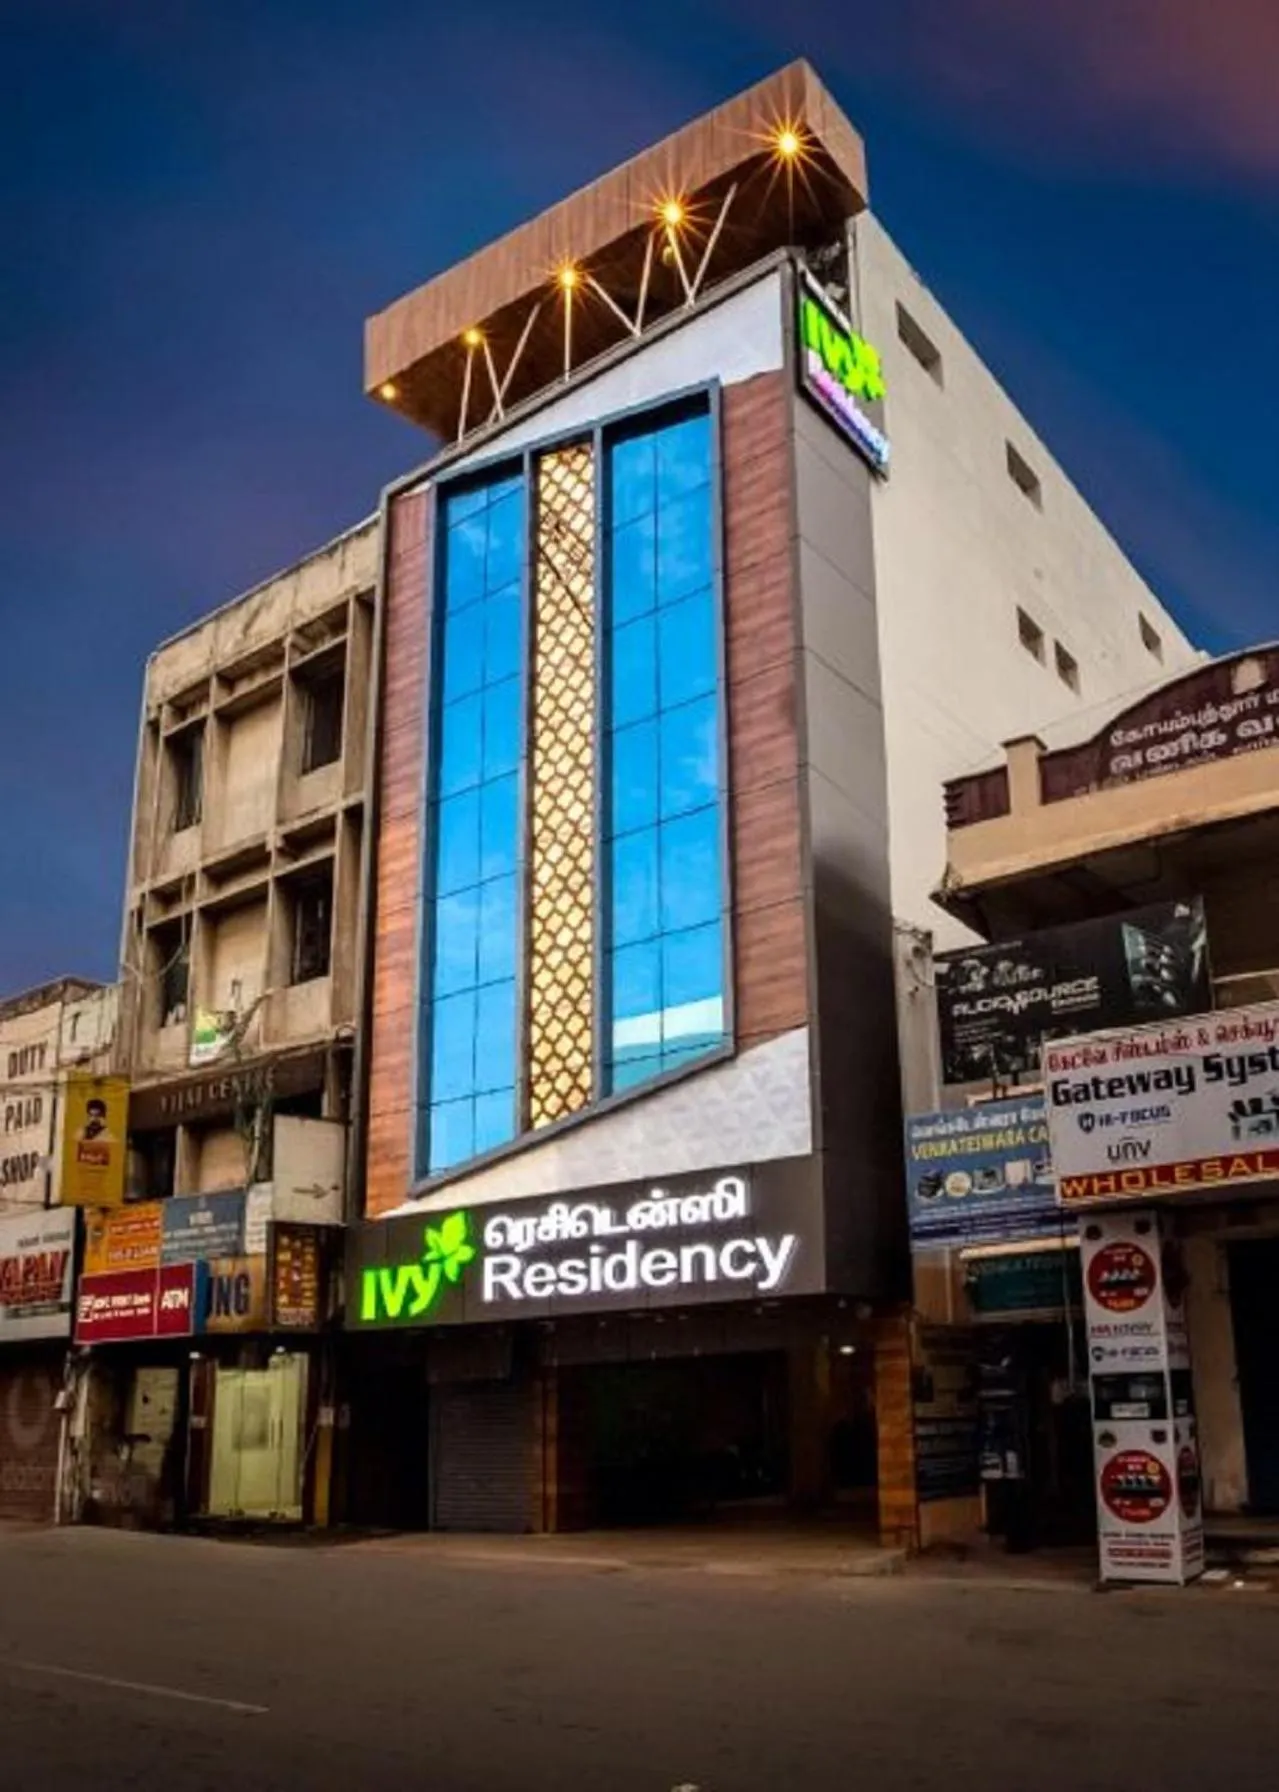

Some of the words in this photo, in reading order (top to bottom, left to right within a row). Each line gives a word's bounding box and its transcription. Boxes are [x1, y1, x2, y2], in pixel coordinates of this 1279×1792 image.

[1110, 729, 1227, 774] வணிக
[1236, 715, 1279, 738] வ
[1198, 1028, 1210, 1046] &
[8, 1040, 48, 1079] DUTY
[1051, 1065, 1196, 1106] Gateway
[1202, 1045, 1279, 1087] Syst
[5, 1096, 42, 1132] PAID
[0, 1150, 39, 1187] SHOP
[1062, 1153, 1279, 1198] WHOLESAL
[484, 1176, 749, 1252] ரெசிடென்ஸி
[482, 1235, 796, 1303] Residency
[160, 1288, 189, 1309] ATM
